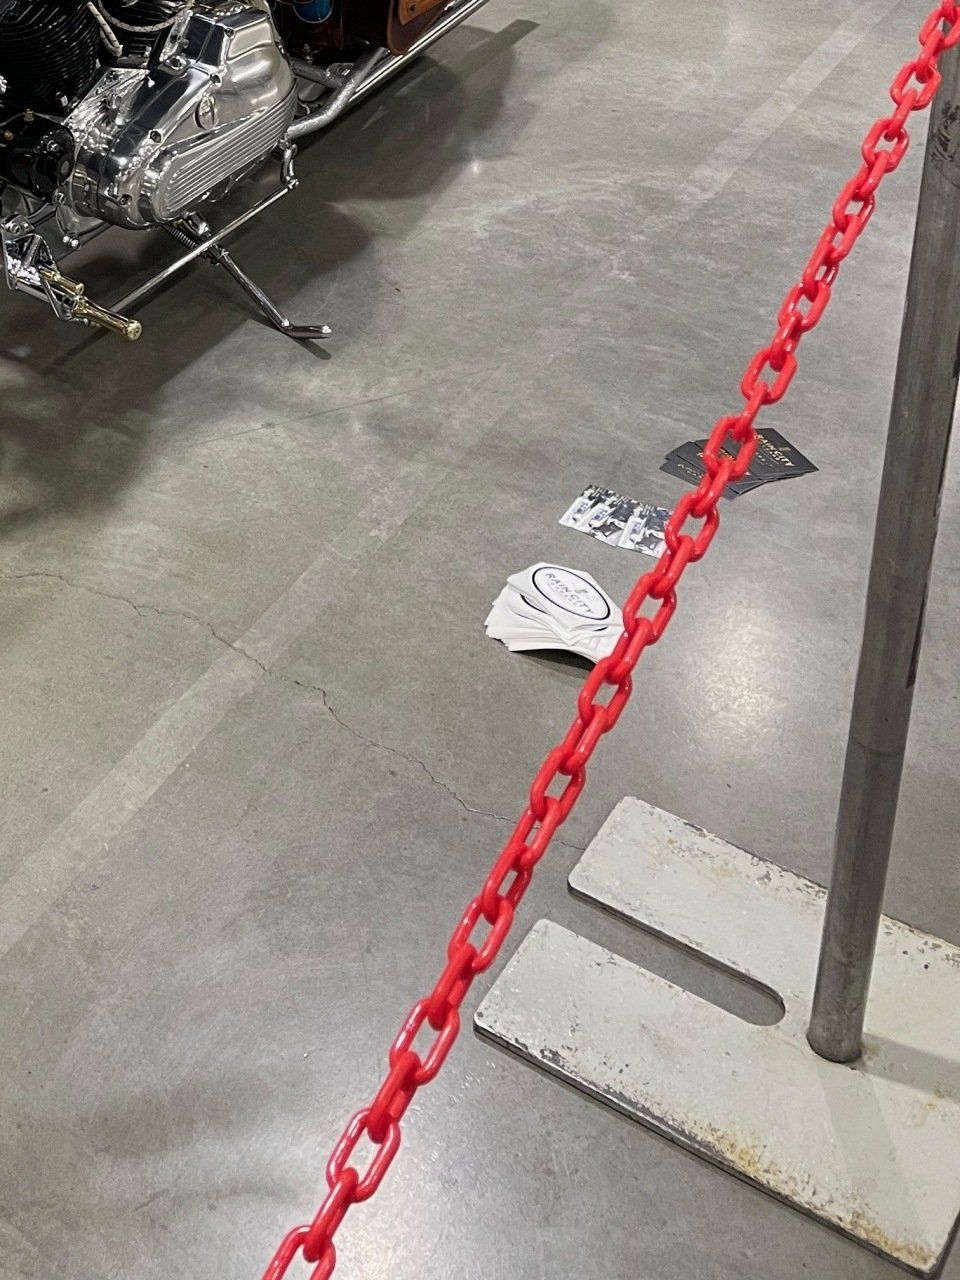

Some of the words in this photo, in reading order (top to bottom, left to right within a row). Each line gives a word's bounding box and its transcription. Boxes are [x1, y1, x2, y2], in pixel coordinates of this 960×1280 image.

[756, 434, 777, 450] RAIN
[773, 451, 795, 466] CITY
[545, 573, 572, 593] RAIN
[570, 594, 594, 613] CITY
